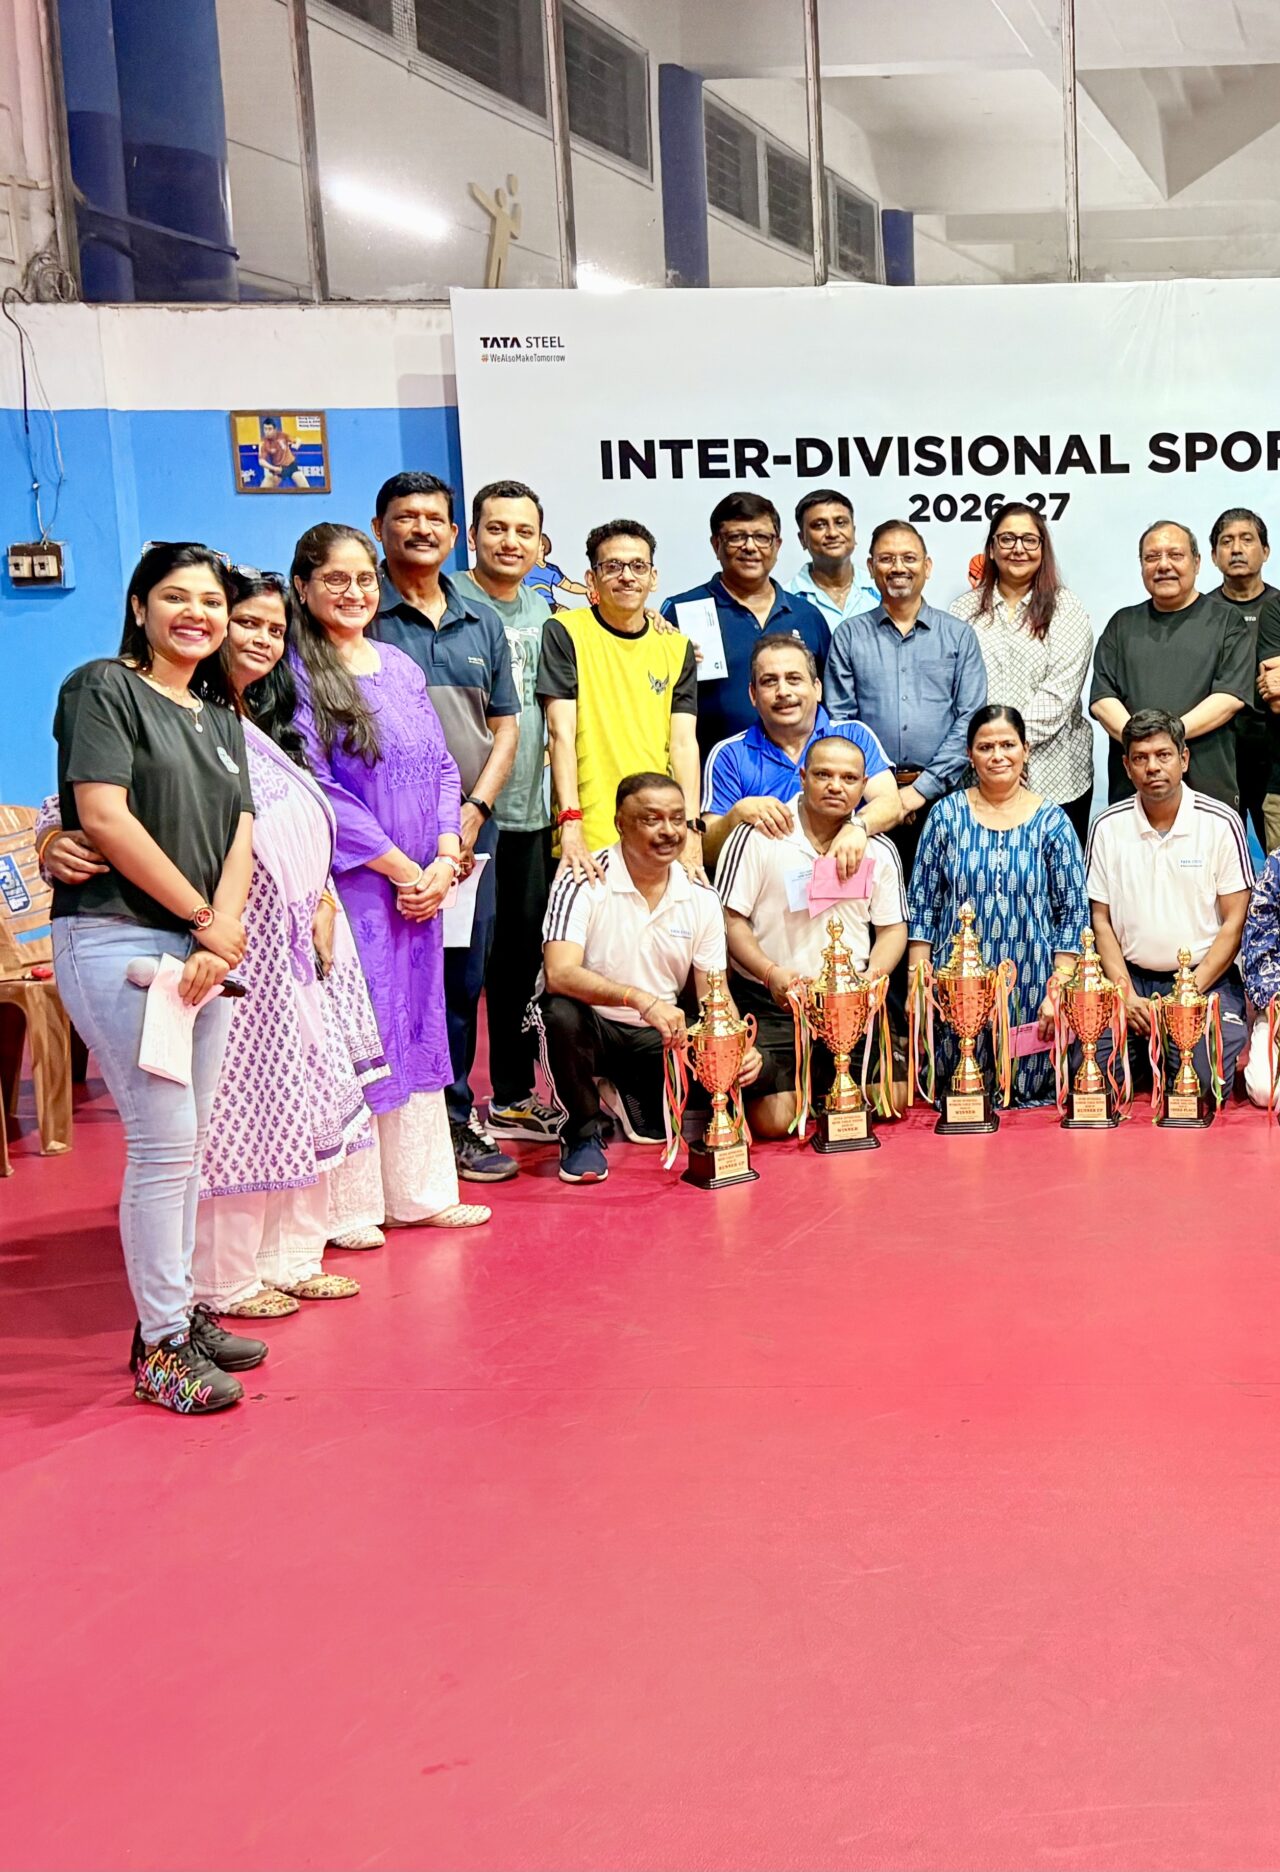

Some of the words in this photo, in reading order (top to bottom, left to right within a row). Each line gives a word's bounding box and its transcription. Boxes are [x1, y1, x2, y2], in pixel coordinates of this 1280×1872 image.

[480, 337, 521, 348] TATA
[525, 336, 565, 348] STEEL
[600, 434, 1130, 480] INTER-DIVISIONAL
